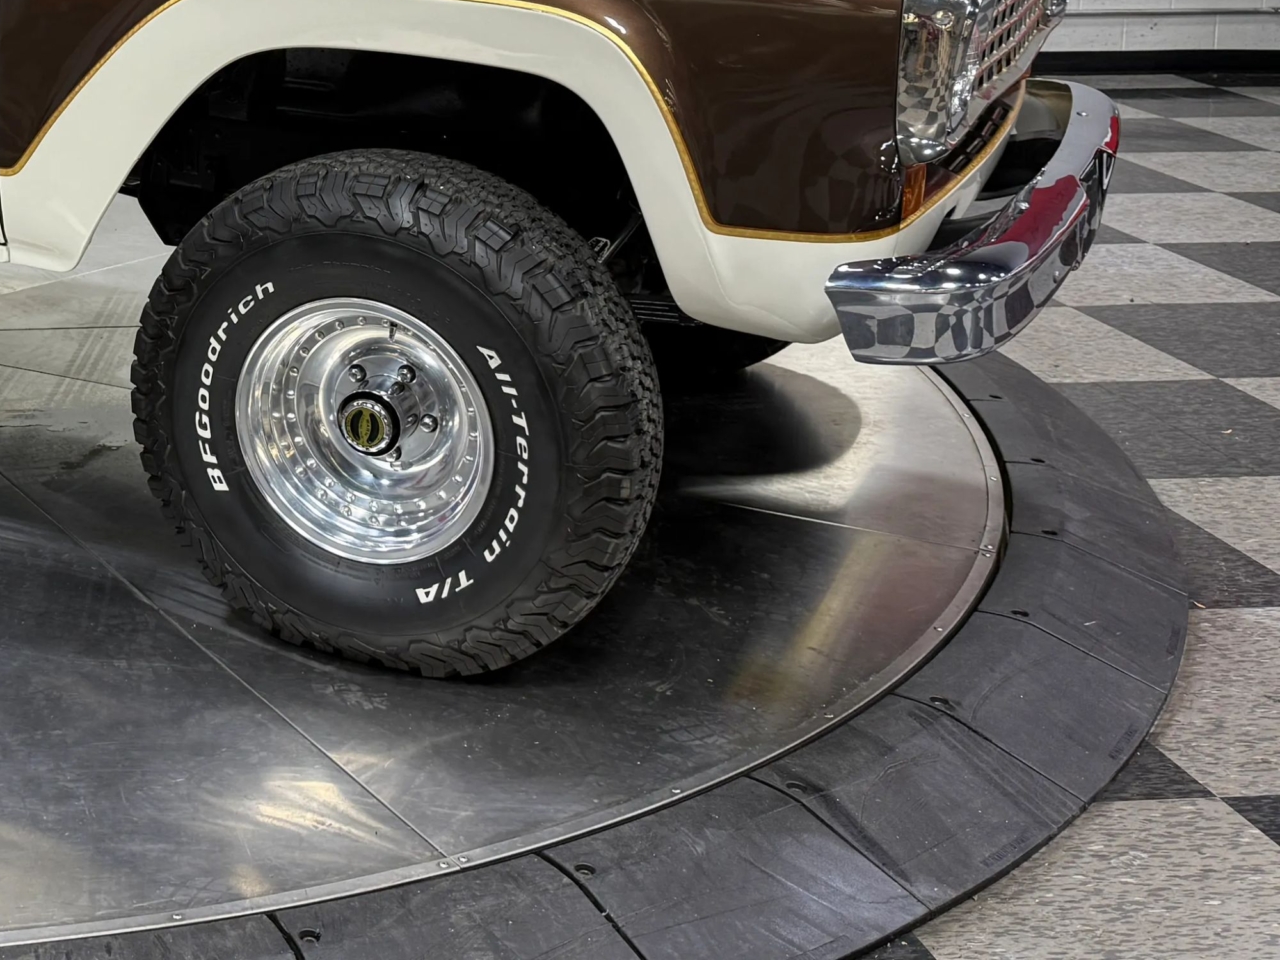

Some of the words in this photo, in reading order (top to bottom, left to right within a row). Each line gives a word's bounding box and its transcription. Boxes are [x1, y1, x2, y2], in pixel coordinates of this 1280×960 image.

[194, 279, 276, 492] BFGoodrich
[475, 344, 532, 563] All-Terrain
[415, 569, 474, 604] T/A
